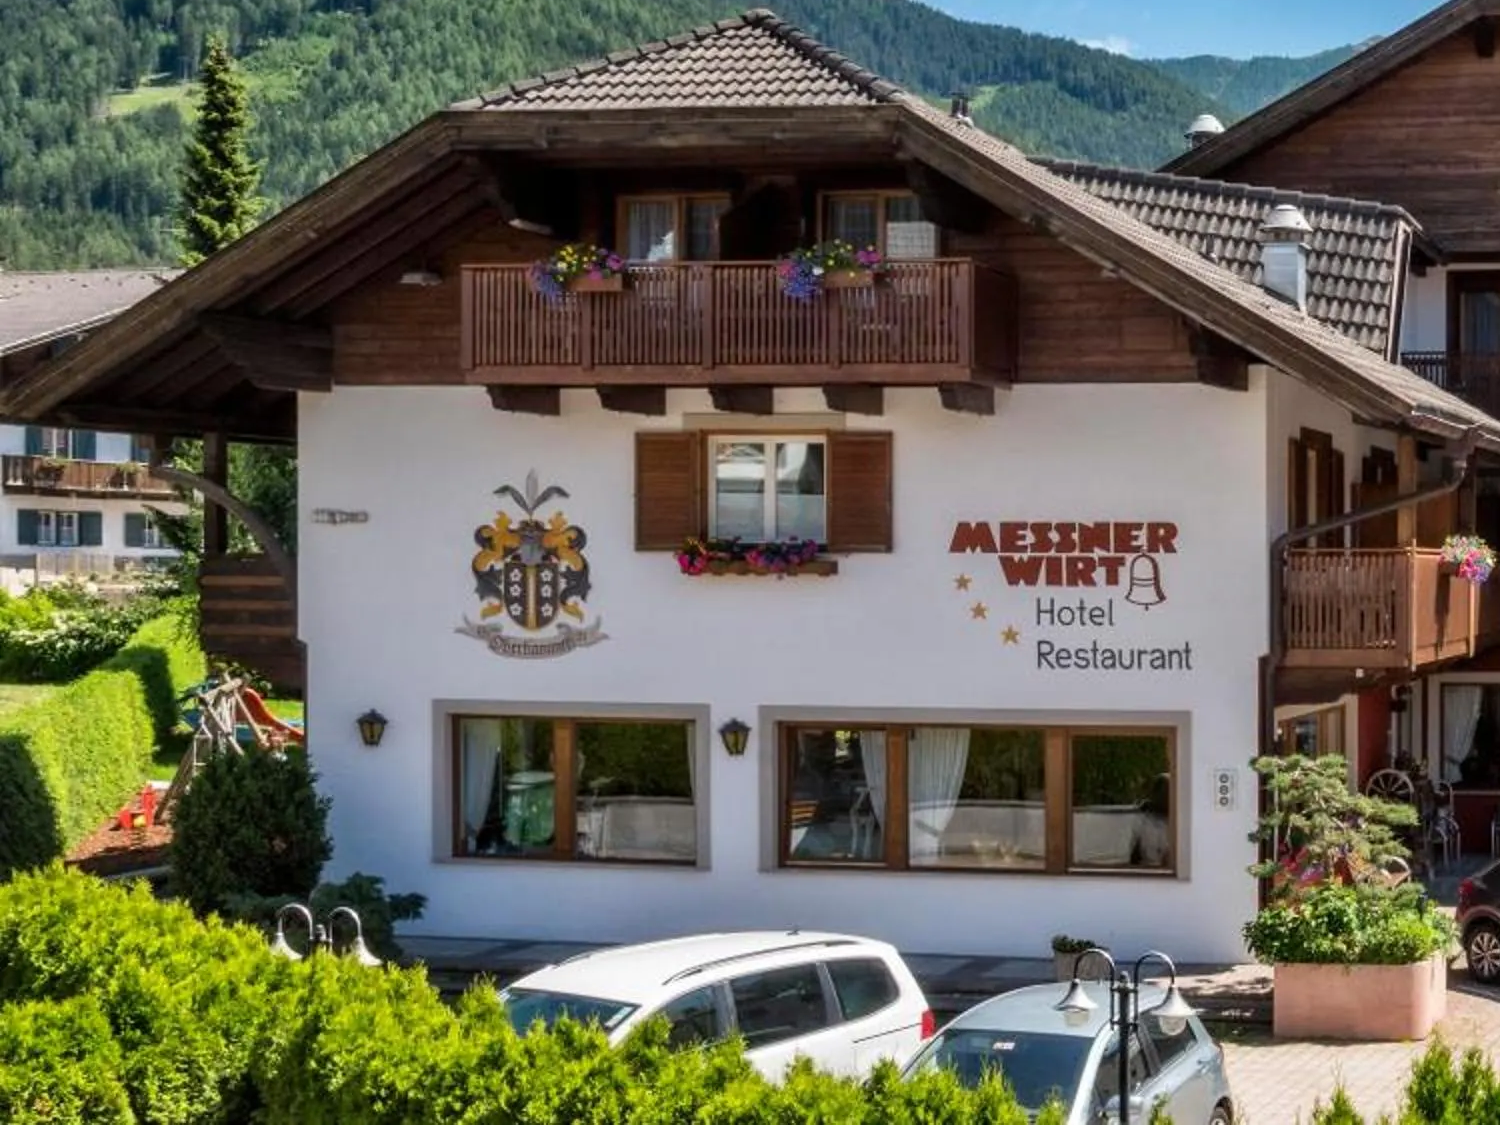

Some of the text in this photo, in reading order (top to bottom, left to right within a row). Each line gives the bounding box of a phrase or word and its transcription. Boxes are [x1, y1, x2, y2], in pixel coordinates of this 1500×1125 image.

[949, 521, 1178, 553] MESSNER
[998, 555, 1126, 587] WIRT
[1036, 597, 1114, 626] Hotel
[1037, 639, 1193, 670] Restaurant
